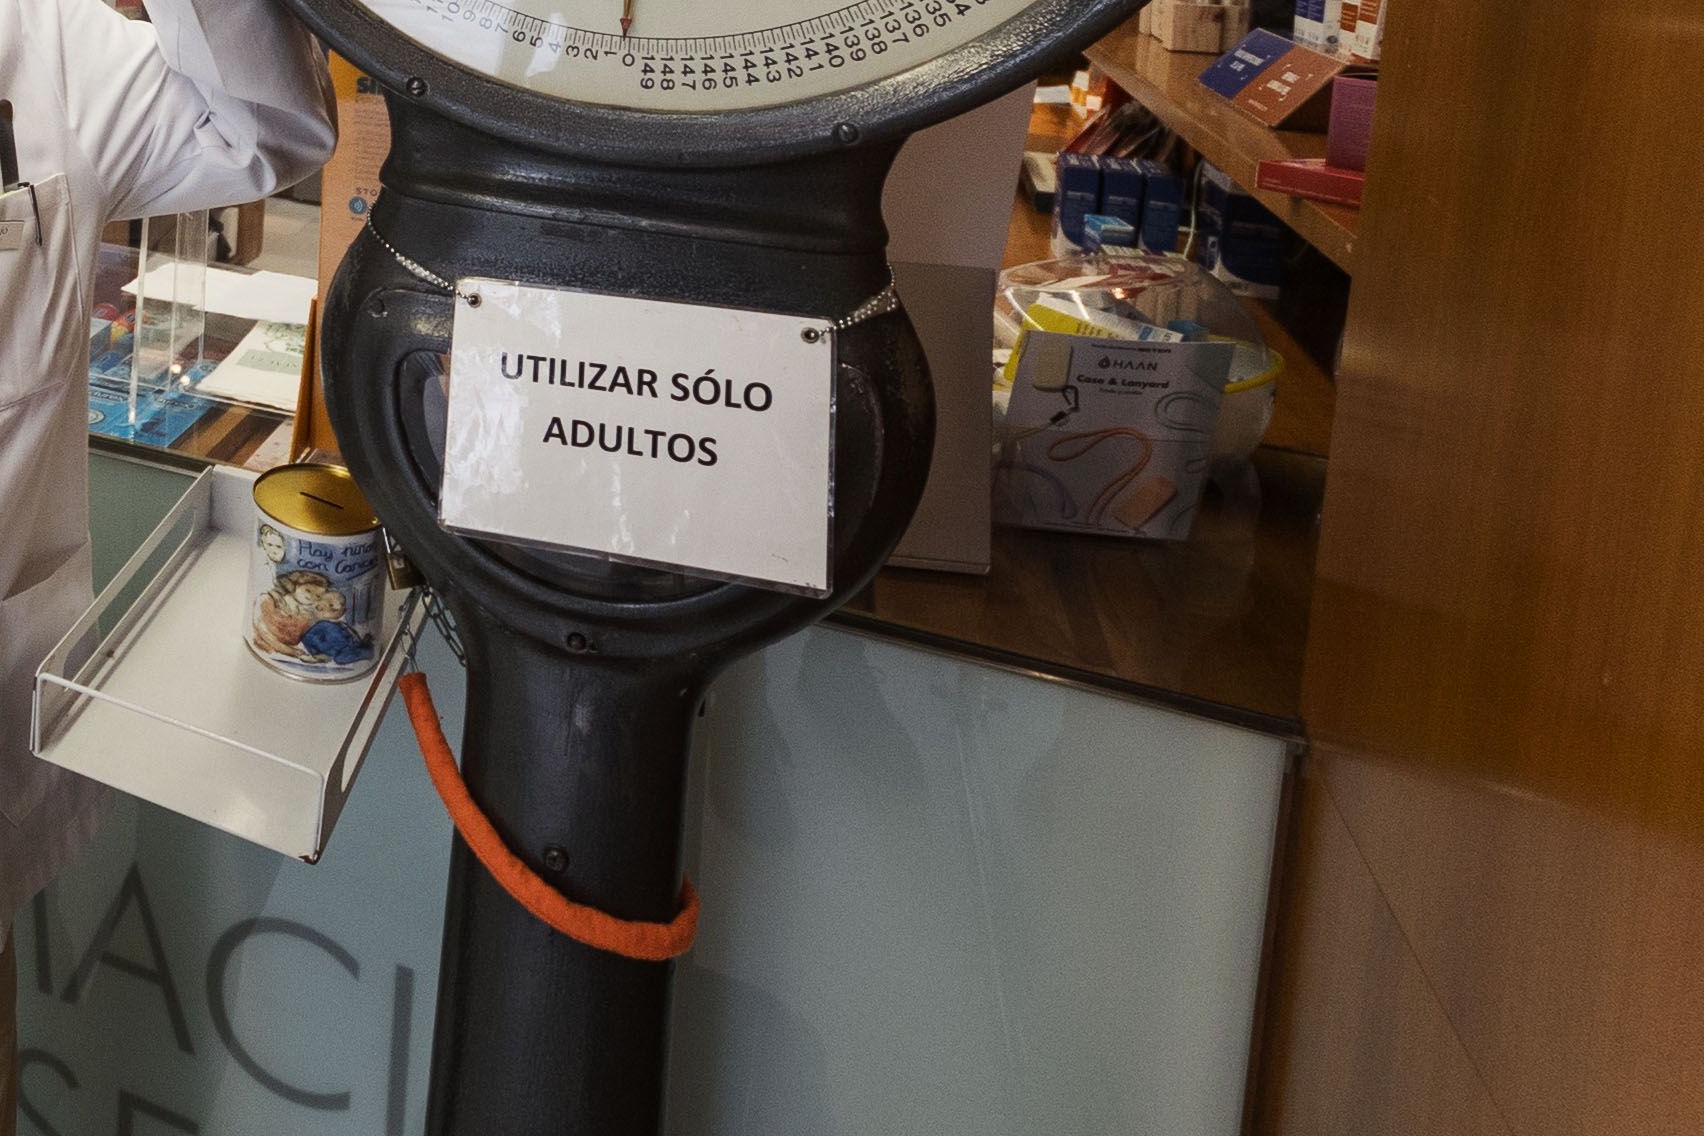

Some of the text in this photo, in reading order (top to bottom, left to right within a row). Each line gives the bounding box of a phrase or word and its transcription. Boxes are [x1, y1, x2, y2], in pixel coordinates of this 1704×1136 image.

[512, 29, 526, 42] 6
[860, 18, 888, 55] 138
[899, 1, 930, 37] 136
[565, 44, 580, 58] 3
[622, 52, 635, 67] 0
[780, 43, 804, 79] 142
[800, 38, 824, 71] 141
[820, 32, 845, 68] 140
[839, 26, 867, 62] 139
[640, 56, 656, 90] 149
[660, 56, 675, 91] 148
[680, 56, 696, 90] 147
[700, 55, 717, 90] 146
[719, 53, 739, 88] 145
[739, 50, 760, 86] 144
[759, 47, 782, 83] 143
[500, 351, 773, 412] UTILIZAR SÓLO
[1076, 374, 1104, 385] Case
[1121, 378, 1170, 390] Lanyard
[542, 416, 719, 466] ADULTOS
[296, 559, 328, 573] con
[298, 539, 334, 562] Hay
